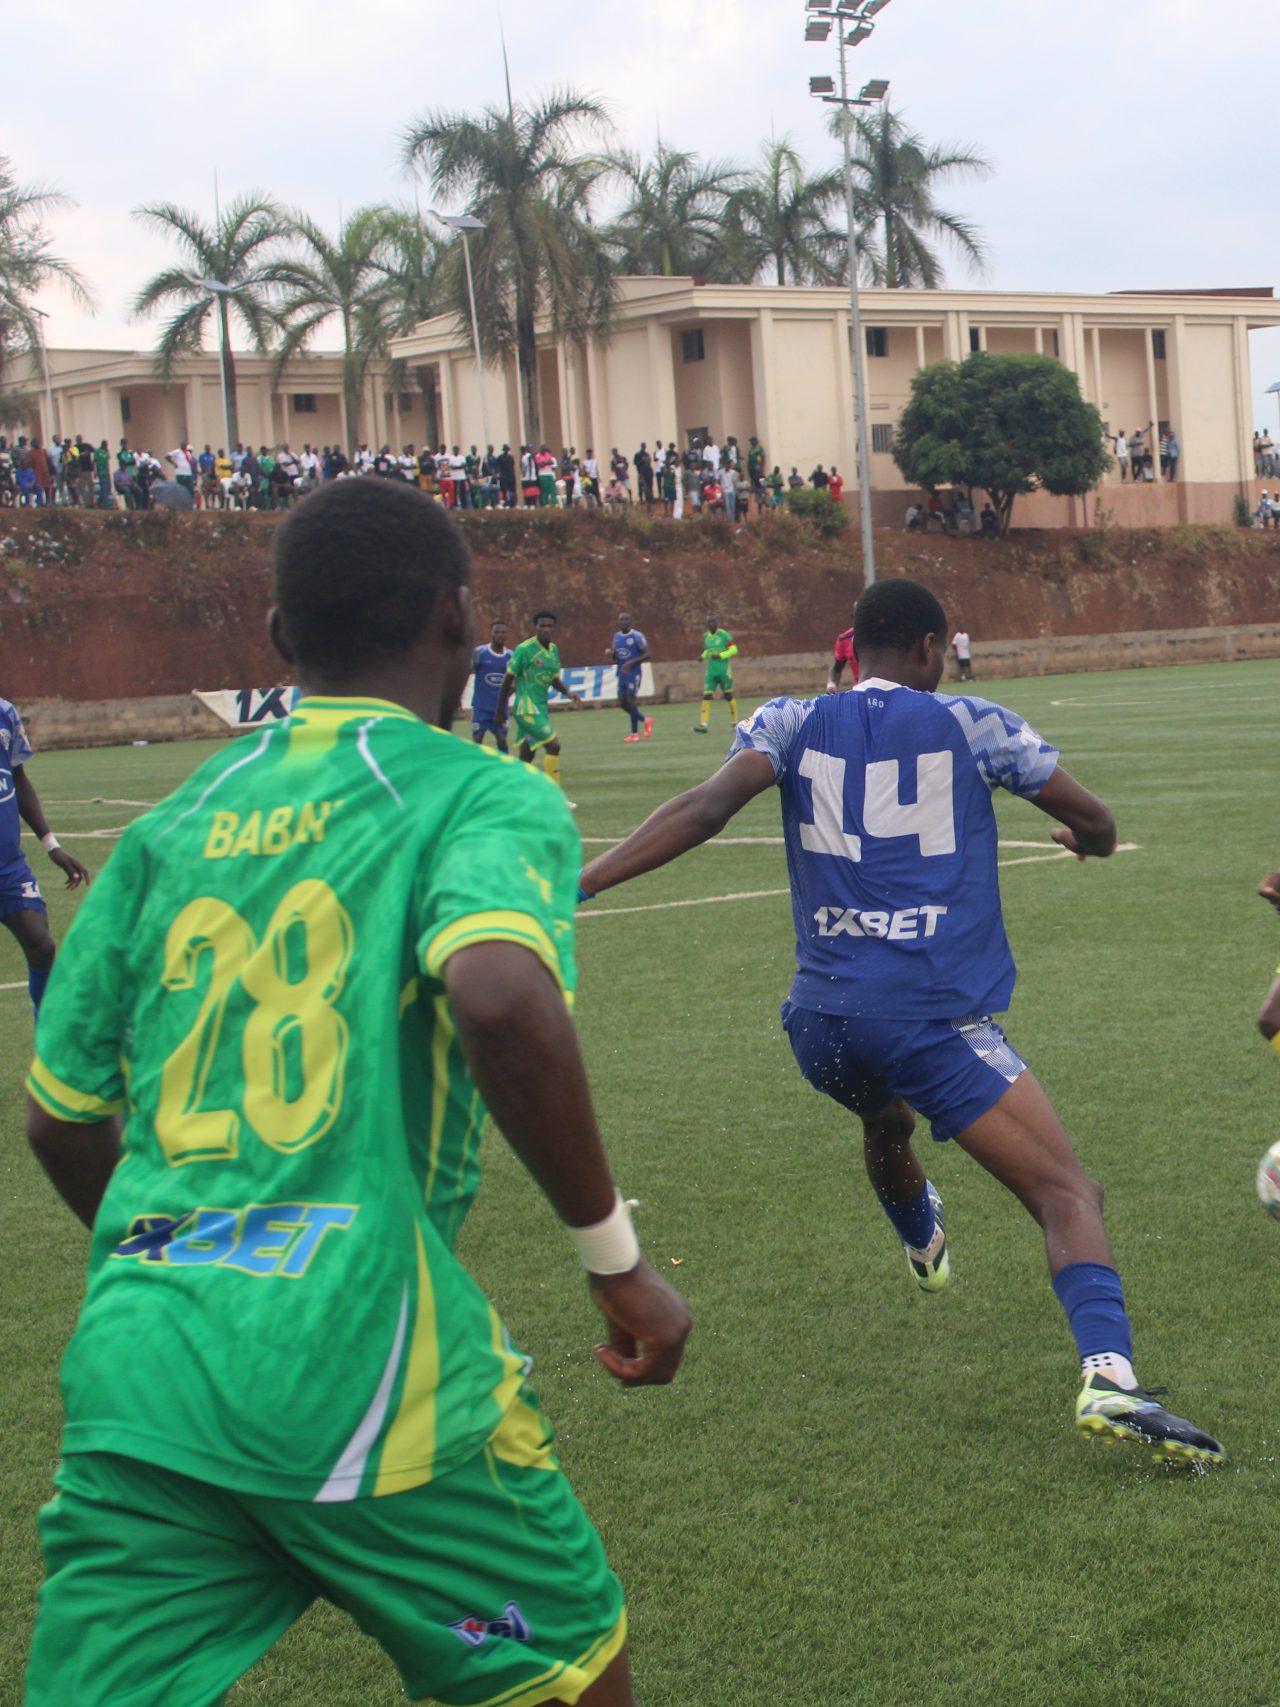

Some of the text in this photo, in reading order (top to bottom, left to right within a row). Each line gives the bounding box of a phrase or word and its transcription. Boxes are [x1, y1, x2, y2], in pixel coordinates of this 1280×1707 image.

[798, 747, 956, 863] 14
[813, 904, 948, 941] 1XBET
[155, 878, 354, 1169] 28
